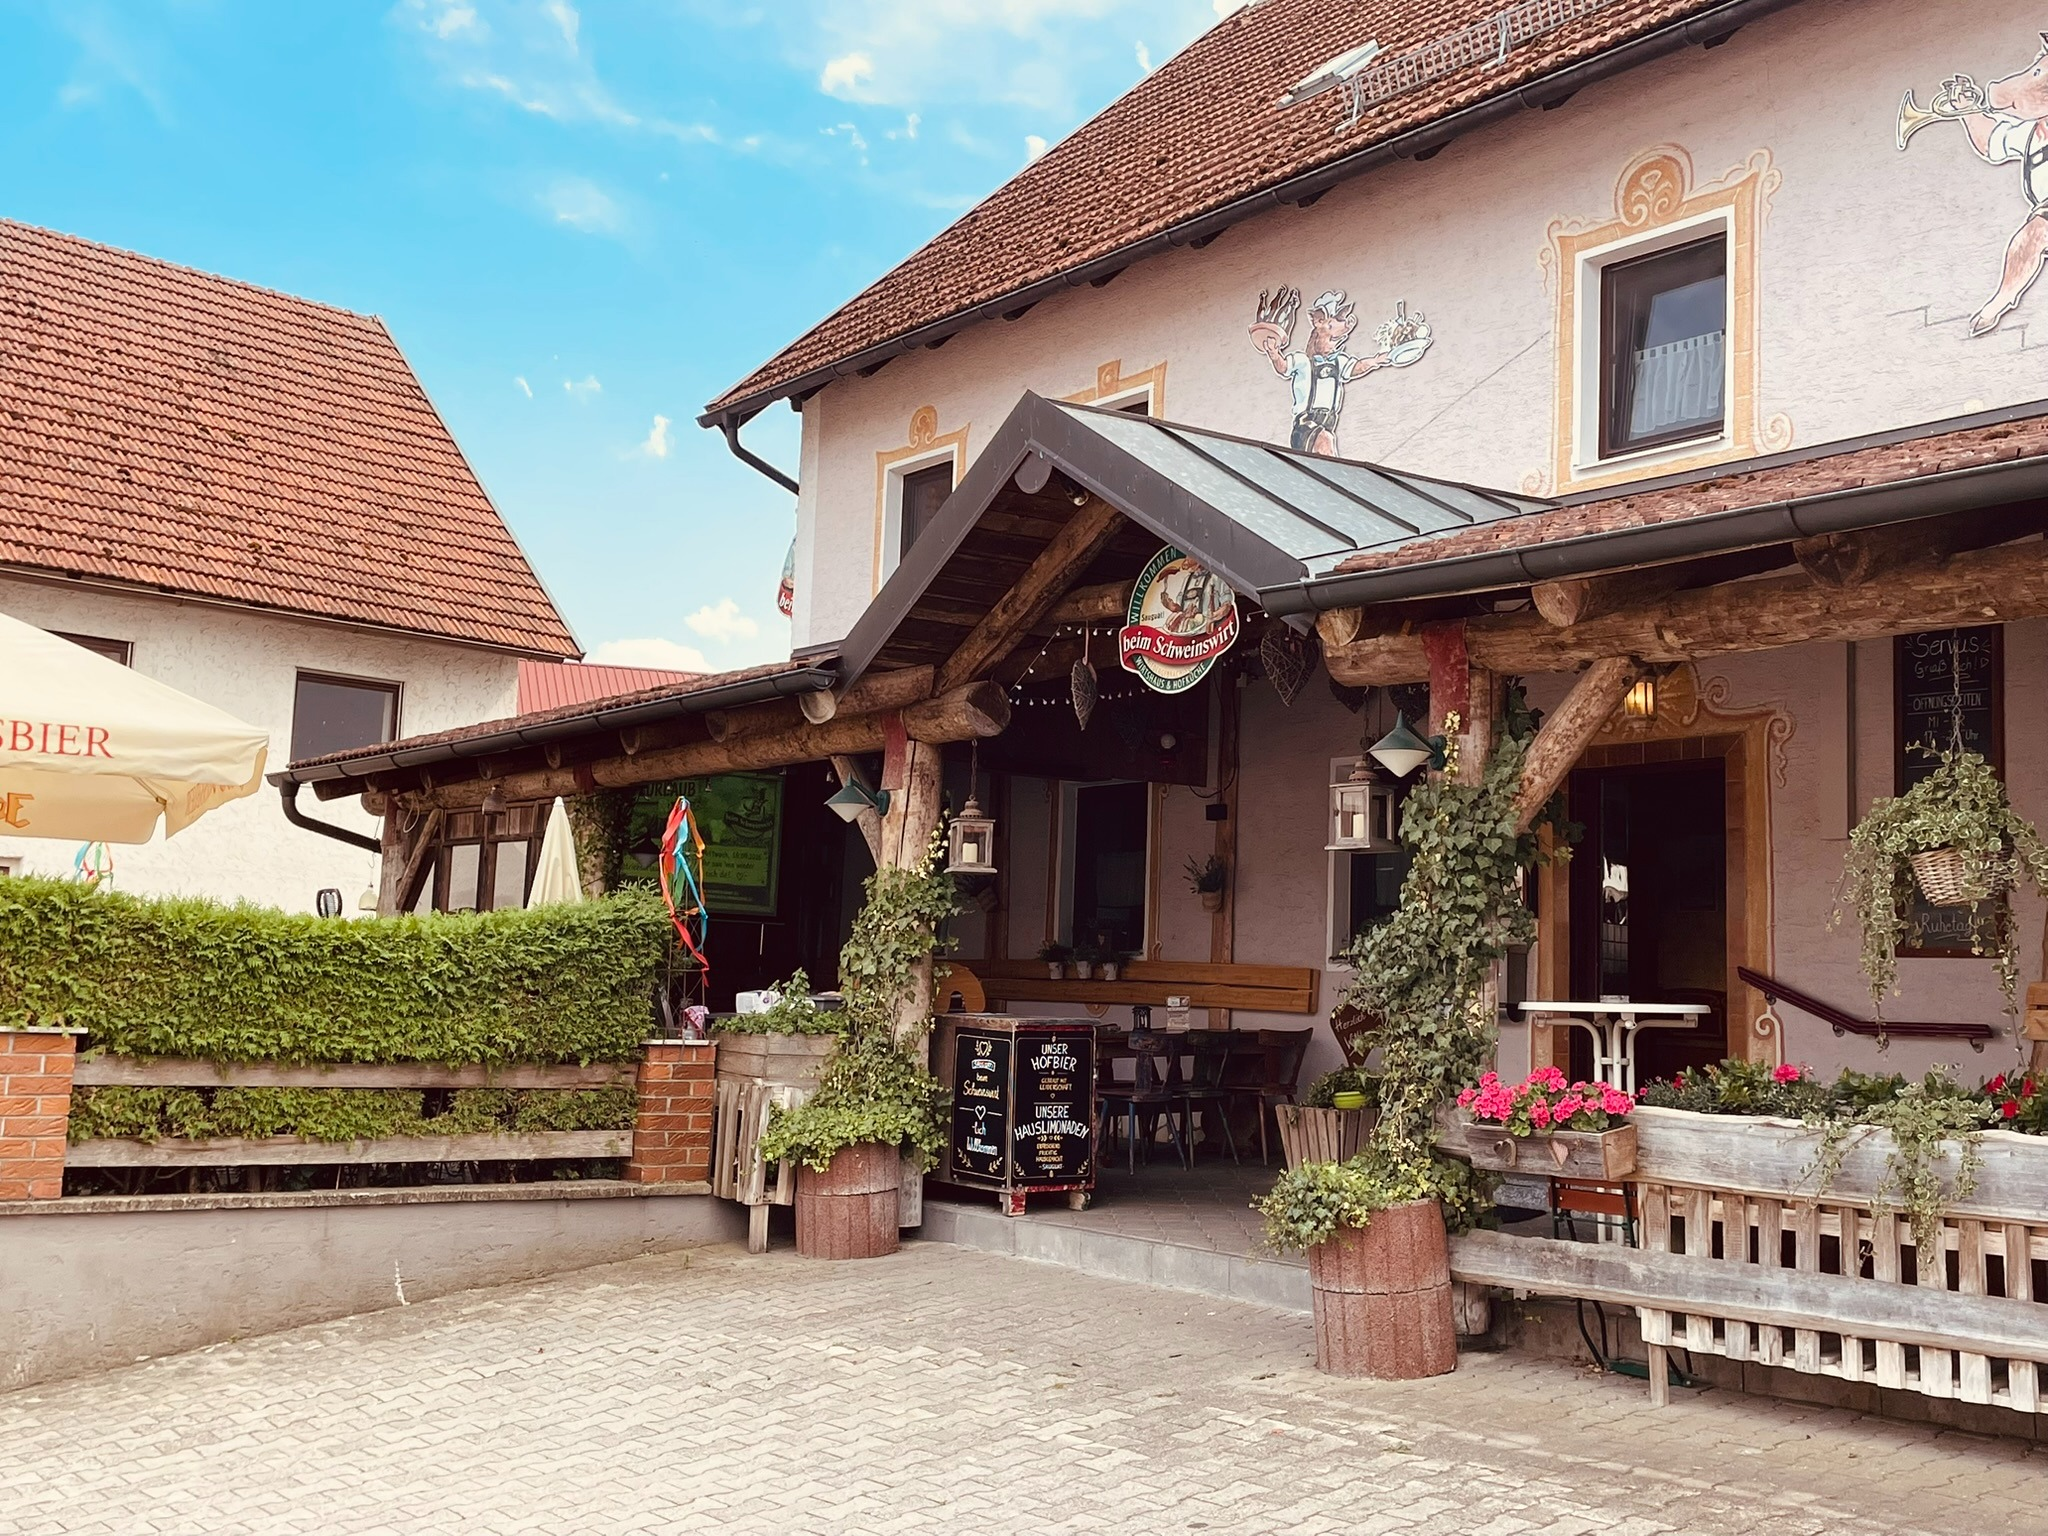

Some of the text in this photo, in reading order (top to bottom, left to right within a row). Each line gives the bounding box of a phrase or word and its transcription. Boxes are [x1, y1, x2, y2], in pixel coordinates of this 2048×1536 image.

[1130, 547, 1177, 623] WILLKOMMEN
[1123, 620, 1235, 659] beim Schweinswirt
[1911, 633, 1980, 658] Servus
[1135, 656, 1166, 688] WIRTSHAUS
[1166, 680, 1171, 690] &
[1921, 912, 1973, 937] Ruhetag
[1041, 1043, 1069, 1055] UNSER
[1030, 1055, 1077, 1072] HOFBIER
[1035, 1105, 1070, 1119] UNSERE
[1013, 1119, 1090, 1141] HAUSLIMONADEN
